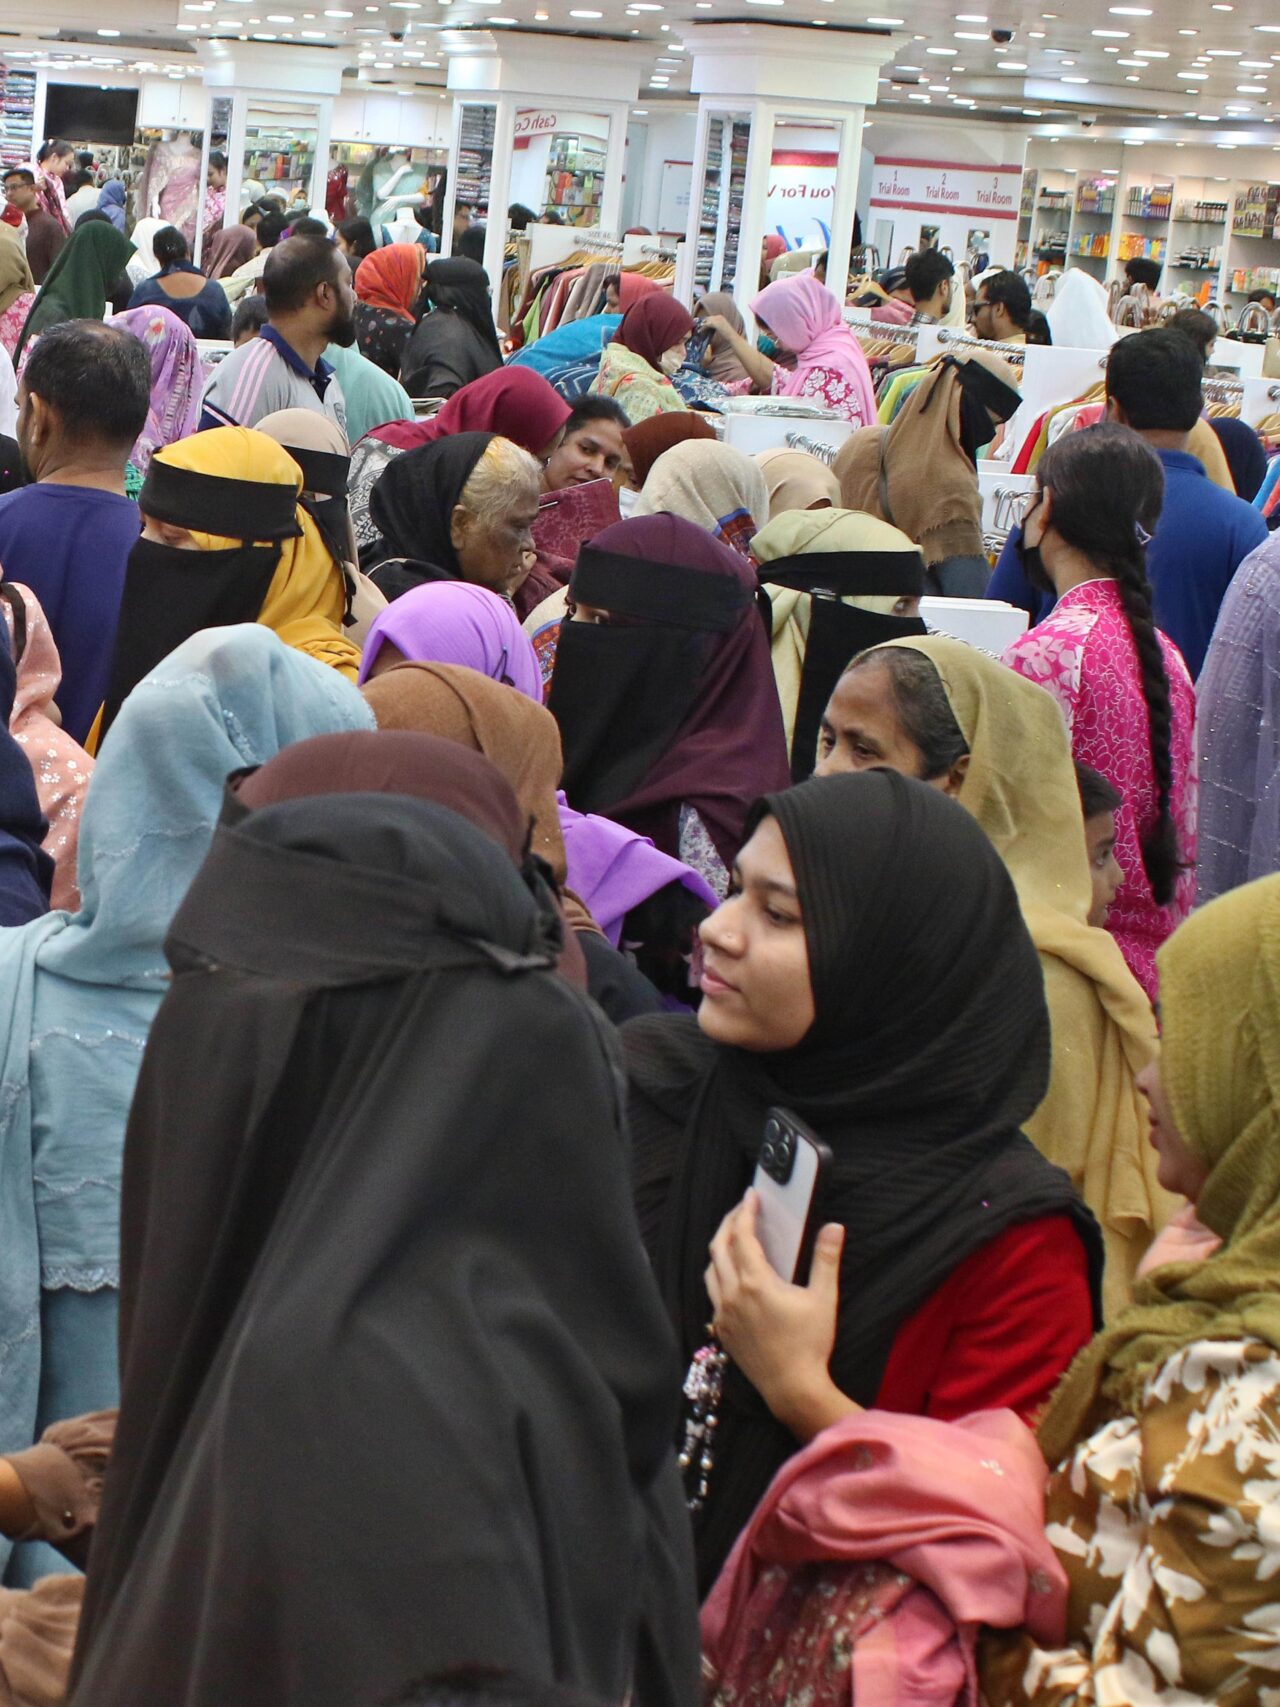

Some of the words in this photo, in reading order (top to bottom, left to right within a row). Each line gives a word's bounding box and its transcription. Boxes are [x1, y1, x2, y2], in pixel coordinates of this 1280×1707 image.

[894, 170, 898, 181] 1
[942, 173, 947, 185] 2
[878, 182, 891, 194] Trial
[892, 185, 910, 196] Room
[993, 177, 999, 189] 3
[926, 186, 939, 198] Trial
[940, 189, 960, 200] Room
[977, 191, 990, 203] Trial
[992, 194, 1012, 205] Room
